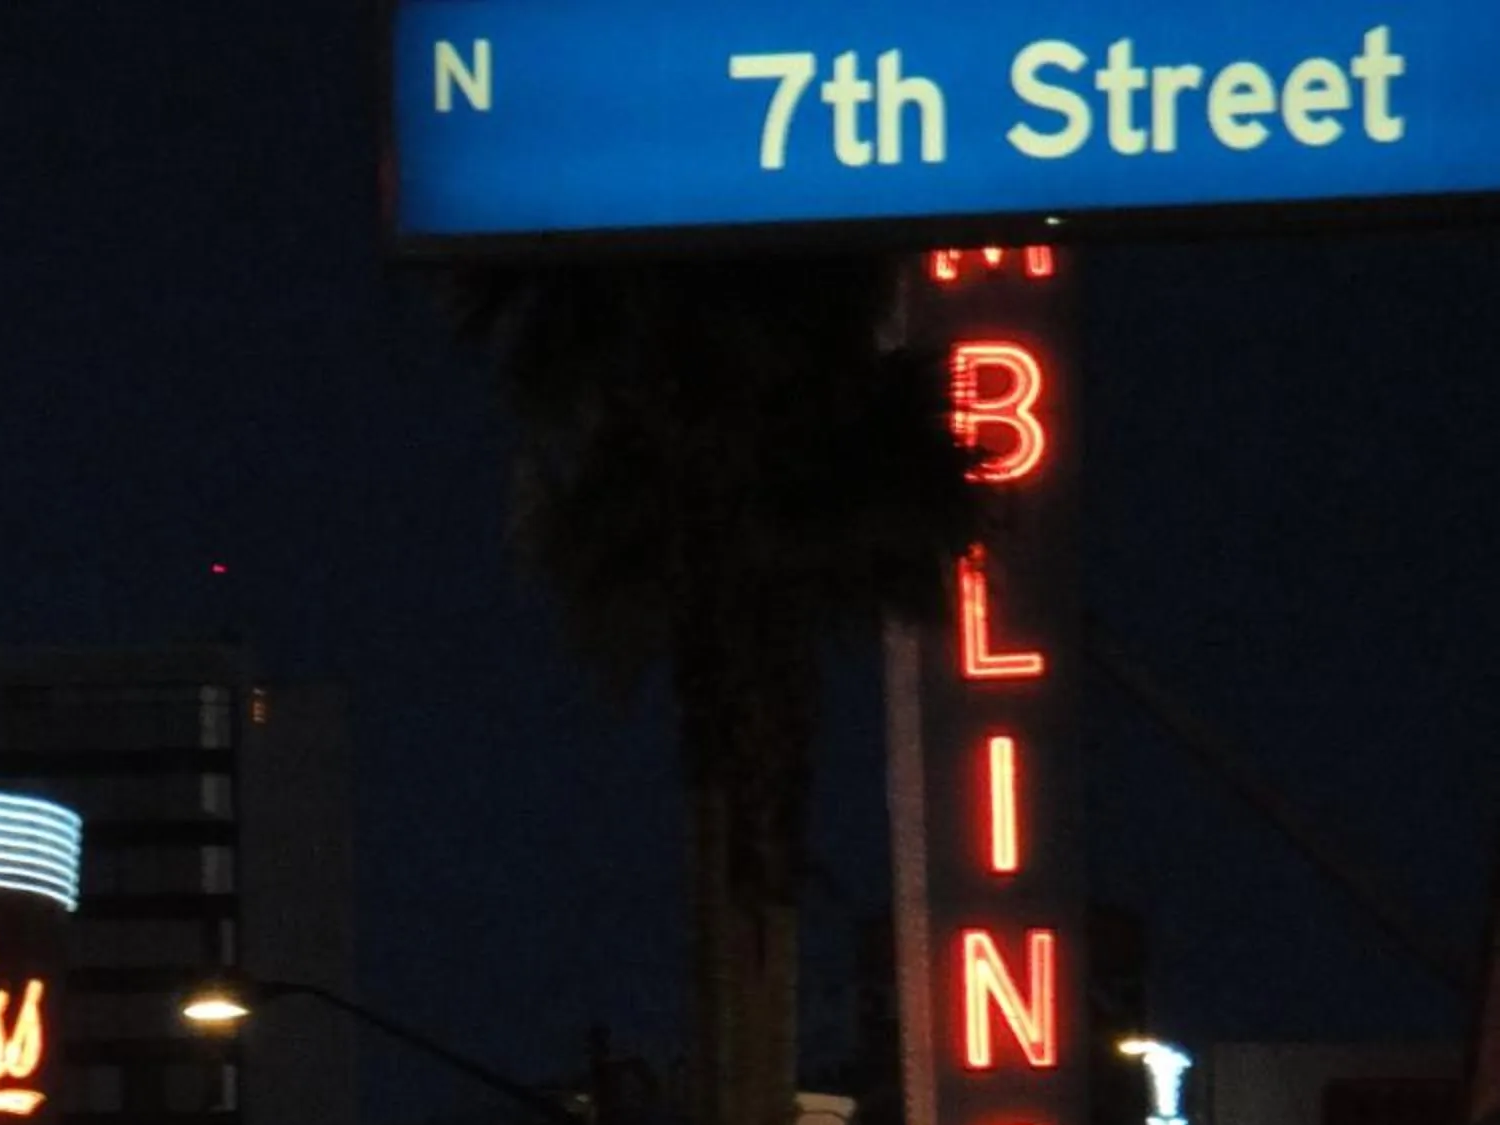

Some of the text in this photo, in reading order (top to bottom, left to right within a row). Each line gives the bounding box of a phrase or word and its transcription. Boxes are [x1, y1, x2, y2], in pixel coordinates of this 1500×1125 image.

[434, 38, 491, 111] N
[729, 26, 1405, 170] 7th Street
